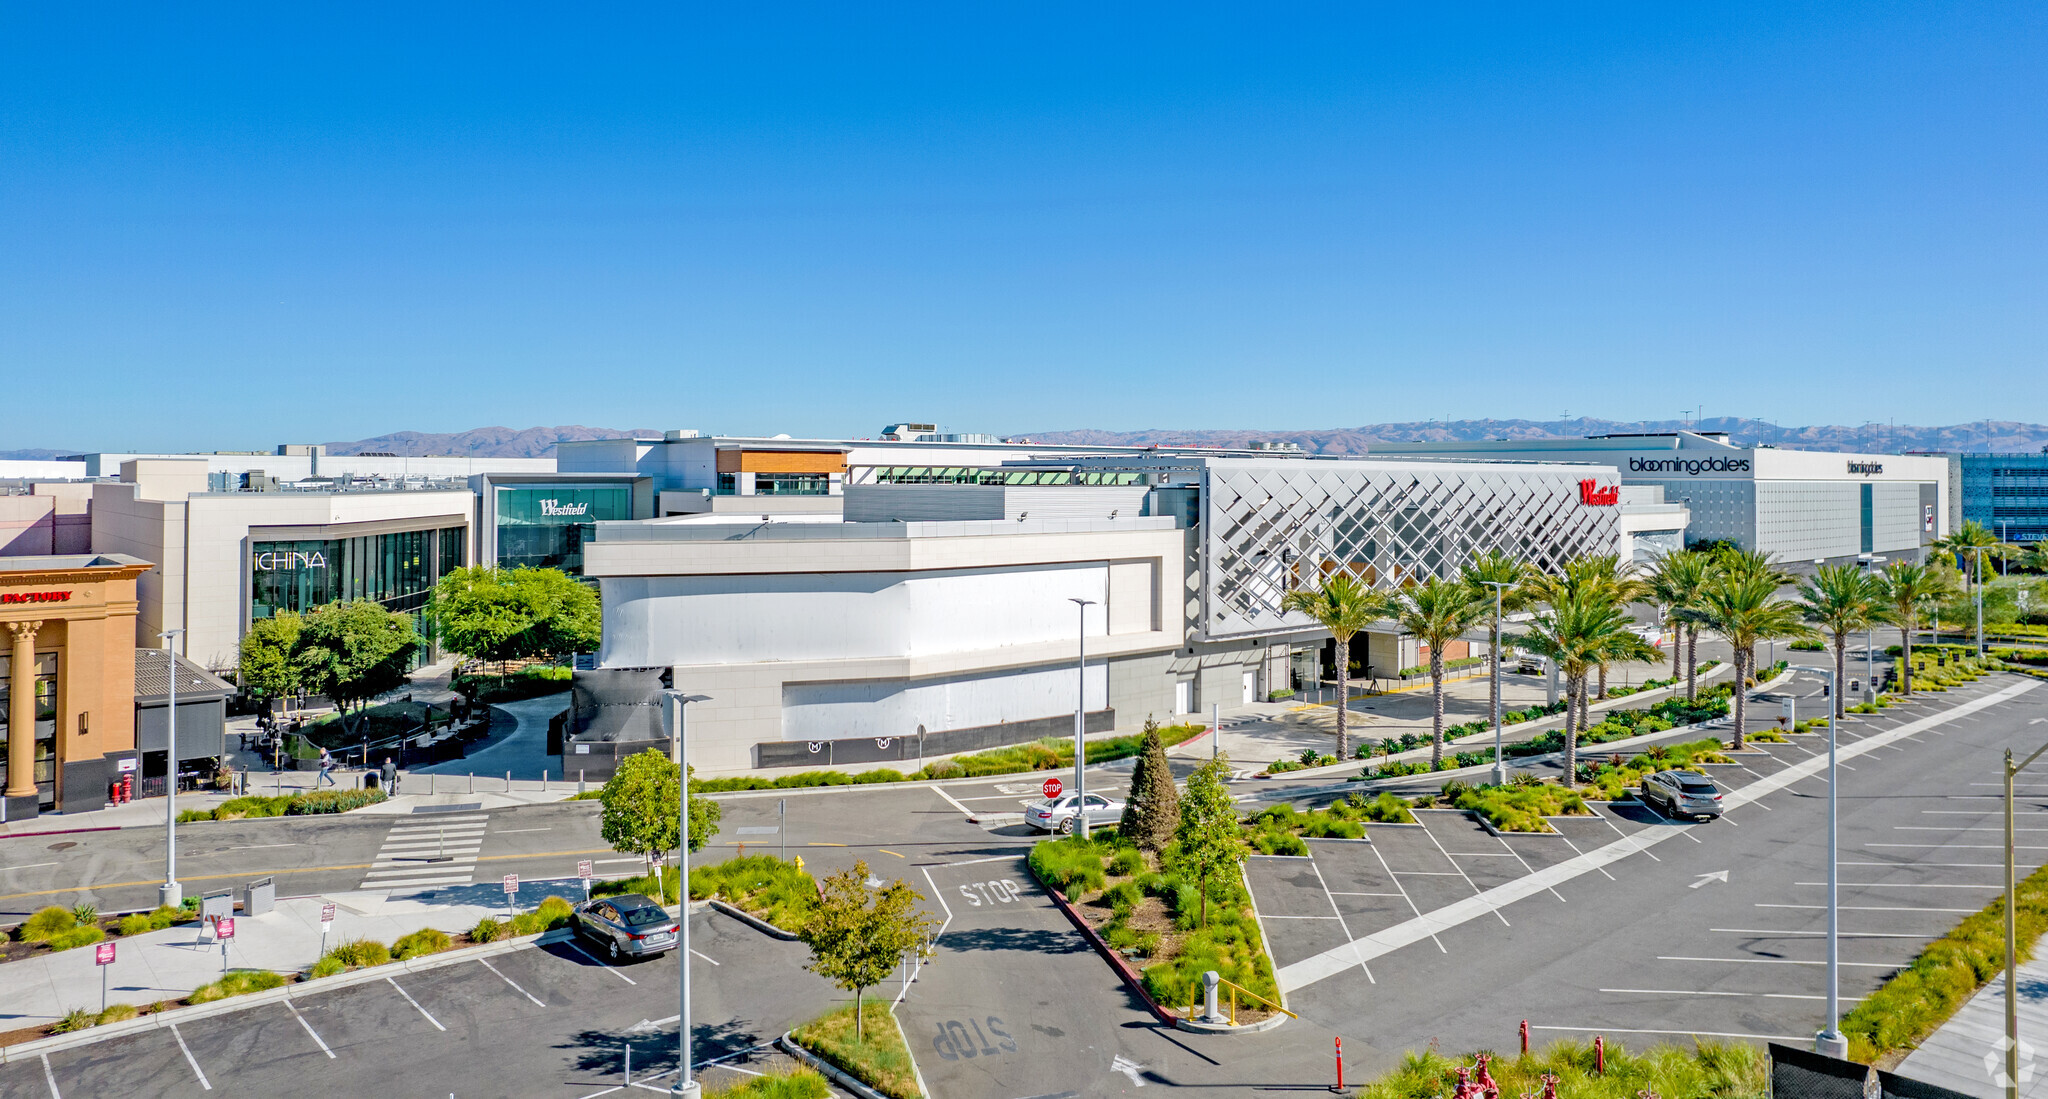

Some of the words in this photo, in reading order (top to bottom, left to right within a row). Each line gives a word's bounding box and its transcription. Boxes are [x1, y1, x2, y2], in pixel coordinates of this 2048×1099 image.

[1629, 456, 1750, 475] bloomingdale's
[1580, 478, 1620, 507] Westfield
[539, 499, 588, 516] Westfield
[3, 591, 73, 604] FACTORY
[1043, 783, 1062, 793] STOP
[959, 879, 1021, 907] STOP
[933, 1016, 1017, 1061] STOP
